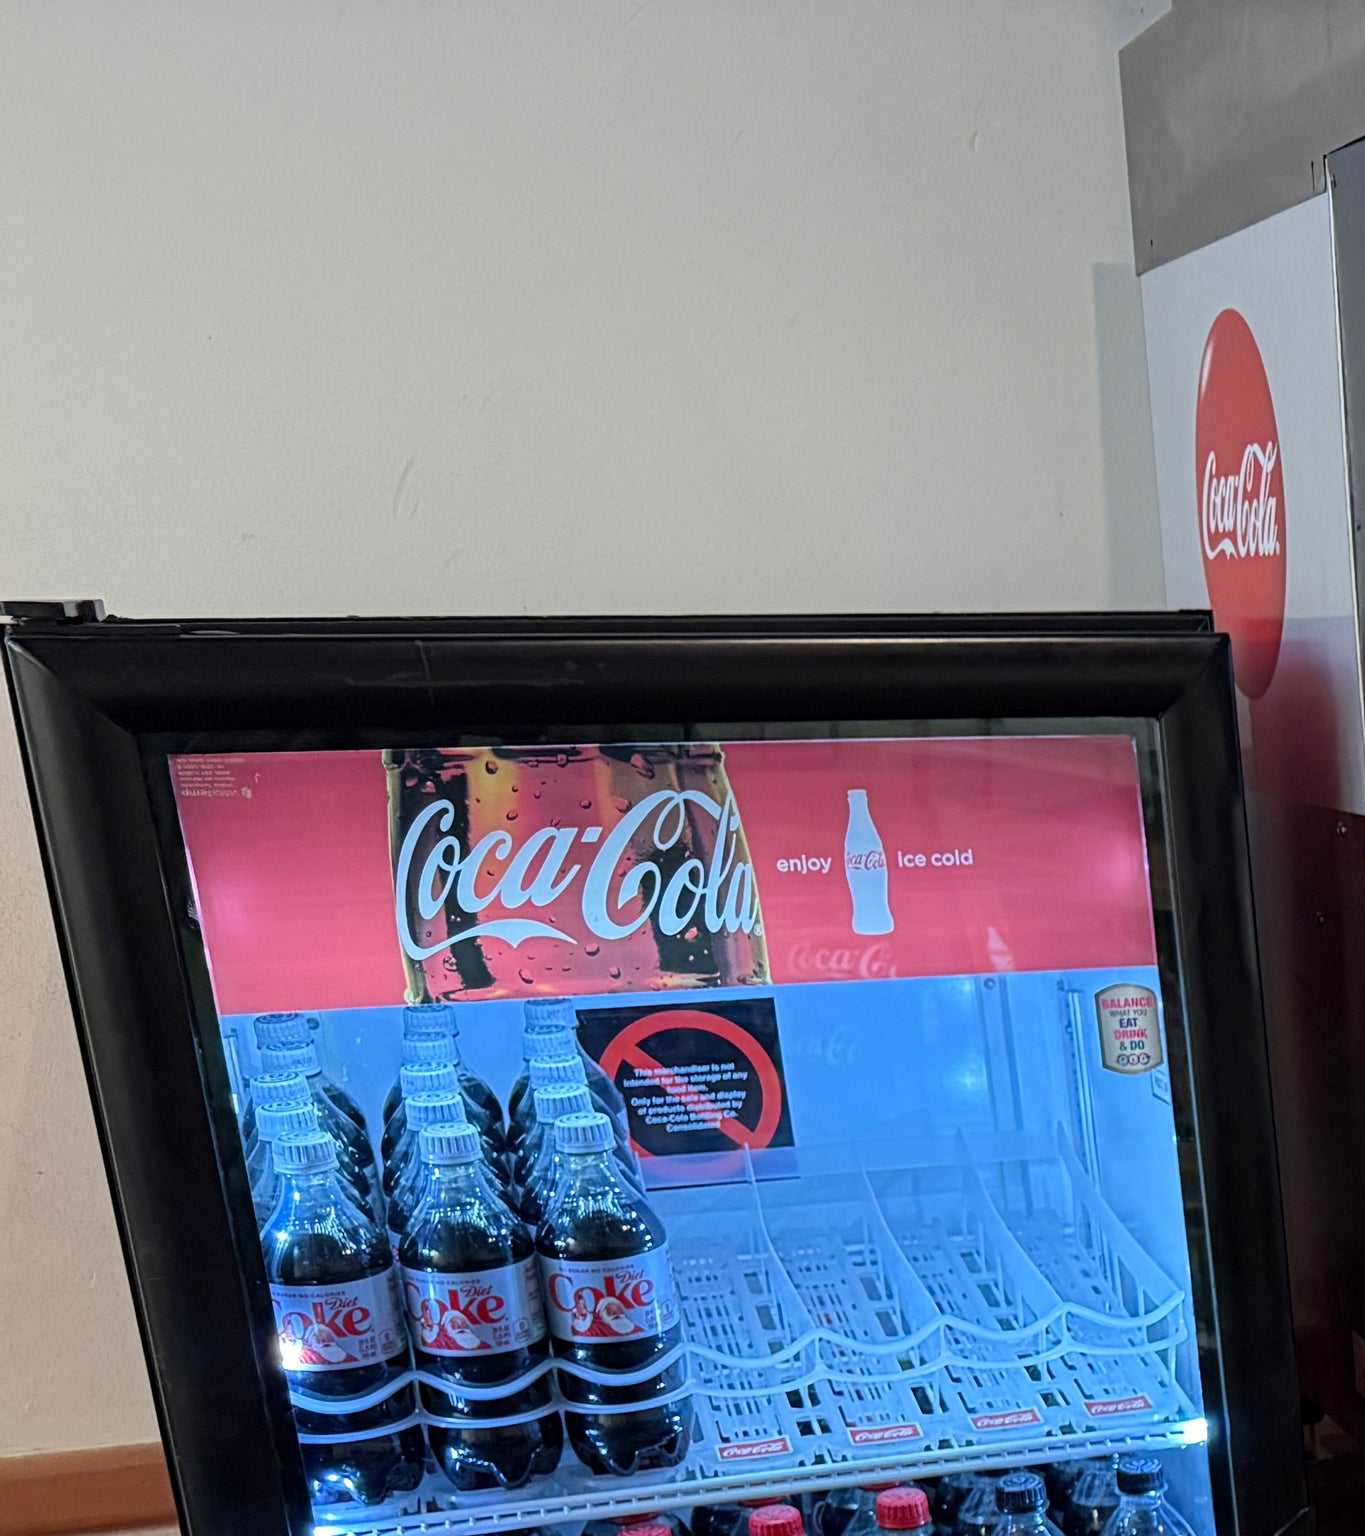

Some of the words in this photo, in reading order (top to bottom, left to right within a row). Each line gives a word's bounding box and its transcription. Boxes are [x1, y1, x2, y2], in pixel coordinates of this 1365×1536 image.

[1203, 437, 1281, 560] Coca-Cola
[776, 854, 832, 875] enjoy
[897, 850, 926, 868] ice
[931, 848, 974, 867] cold
[395, 789, 763, 961] Coca-Cola
[1101, 996, 1154, 1009] BALANCE
[1109, 1008, 1130, 1017] WHAT
[1133, 1008, 1147, 1016] YOU
[1119, 1018, 1138, 1029] EAT
[1114, 1029, 1148, 1040] DRINK
[1130, 1040, 1144, 1050] DO
[615, 1269, 645, 1284] Diet
[460, 1285, 493, 1297] Diet
[550, 1272, 655, 1314] Coke
[325, 1296, 358, 1310] Diet
[404, 1281, 506, 1327] Coke
[271, 1299, 374, 1338] oke
